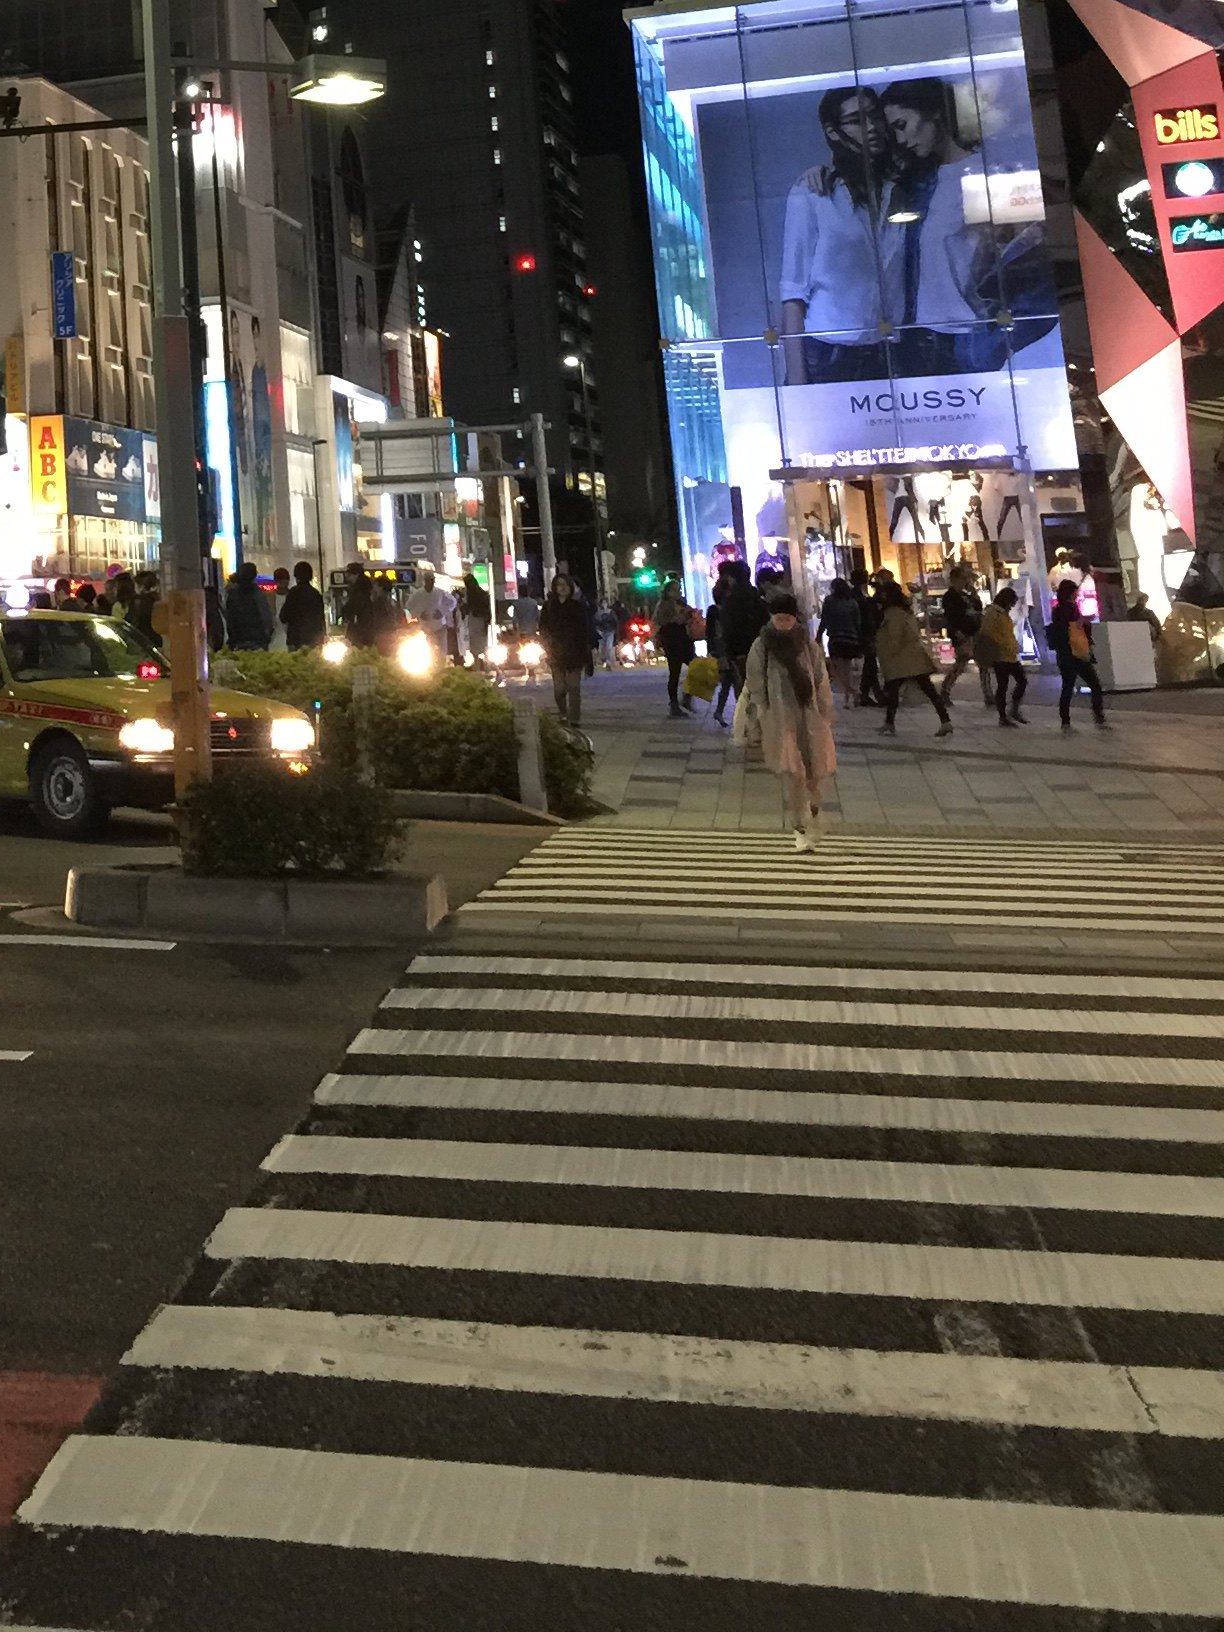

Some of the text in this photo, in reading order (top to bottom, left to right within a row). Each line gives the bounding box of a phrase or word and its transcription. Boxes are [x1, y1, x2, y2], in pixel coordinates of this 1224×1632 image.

[1154, 109, 1218, 143] bills
[59, 325, 73, 336] 5F
[850, 387, 986, 414] MOUSSY
[900, 413, 977, 425] ANNIVERSARY
